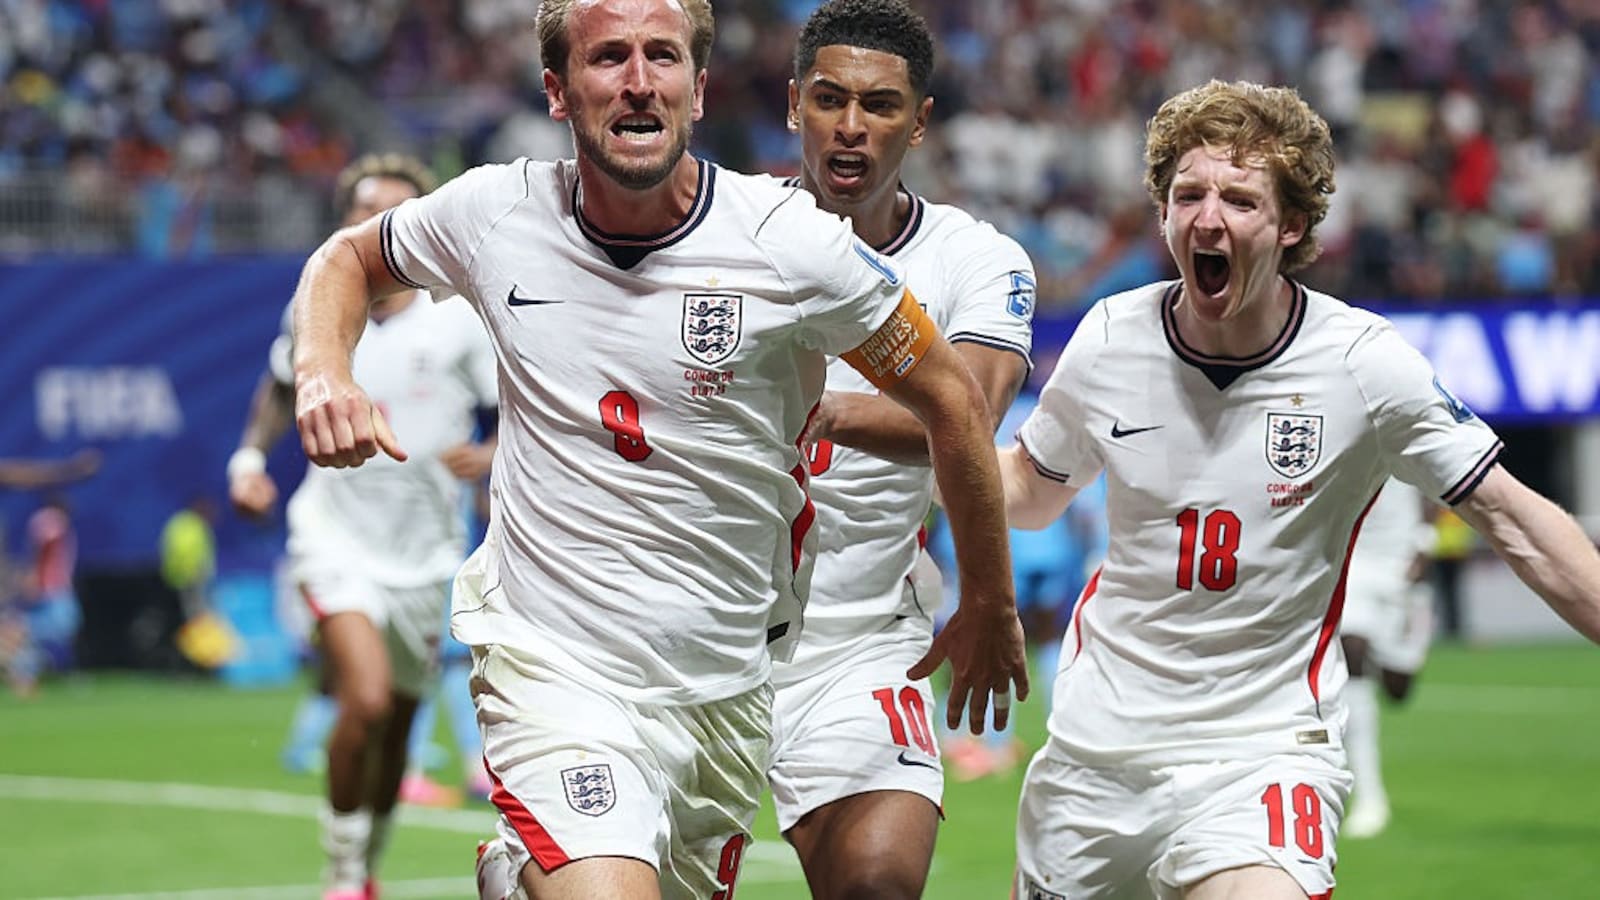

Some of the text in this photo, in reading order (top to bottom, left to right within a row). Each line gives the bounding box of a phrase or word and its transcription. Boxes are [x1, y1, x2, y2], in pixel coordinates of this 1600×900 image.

[860, 311, 905, 357] FOOTBALL
[867, 318, 912, 367] UNITES
[1176, 507, 1242, 592] 18
[872, 685, 936, 757] 10
[1261, 782, 1324, 860] 18
[710, 832, 744, 900] 9
